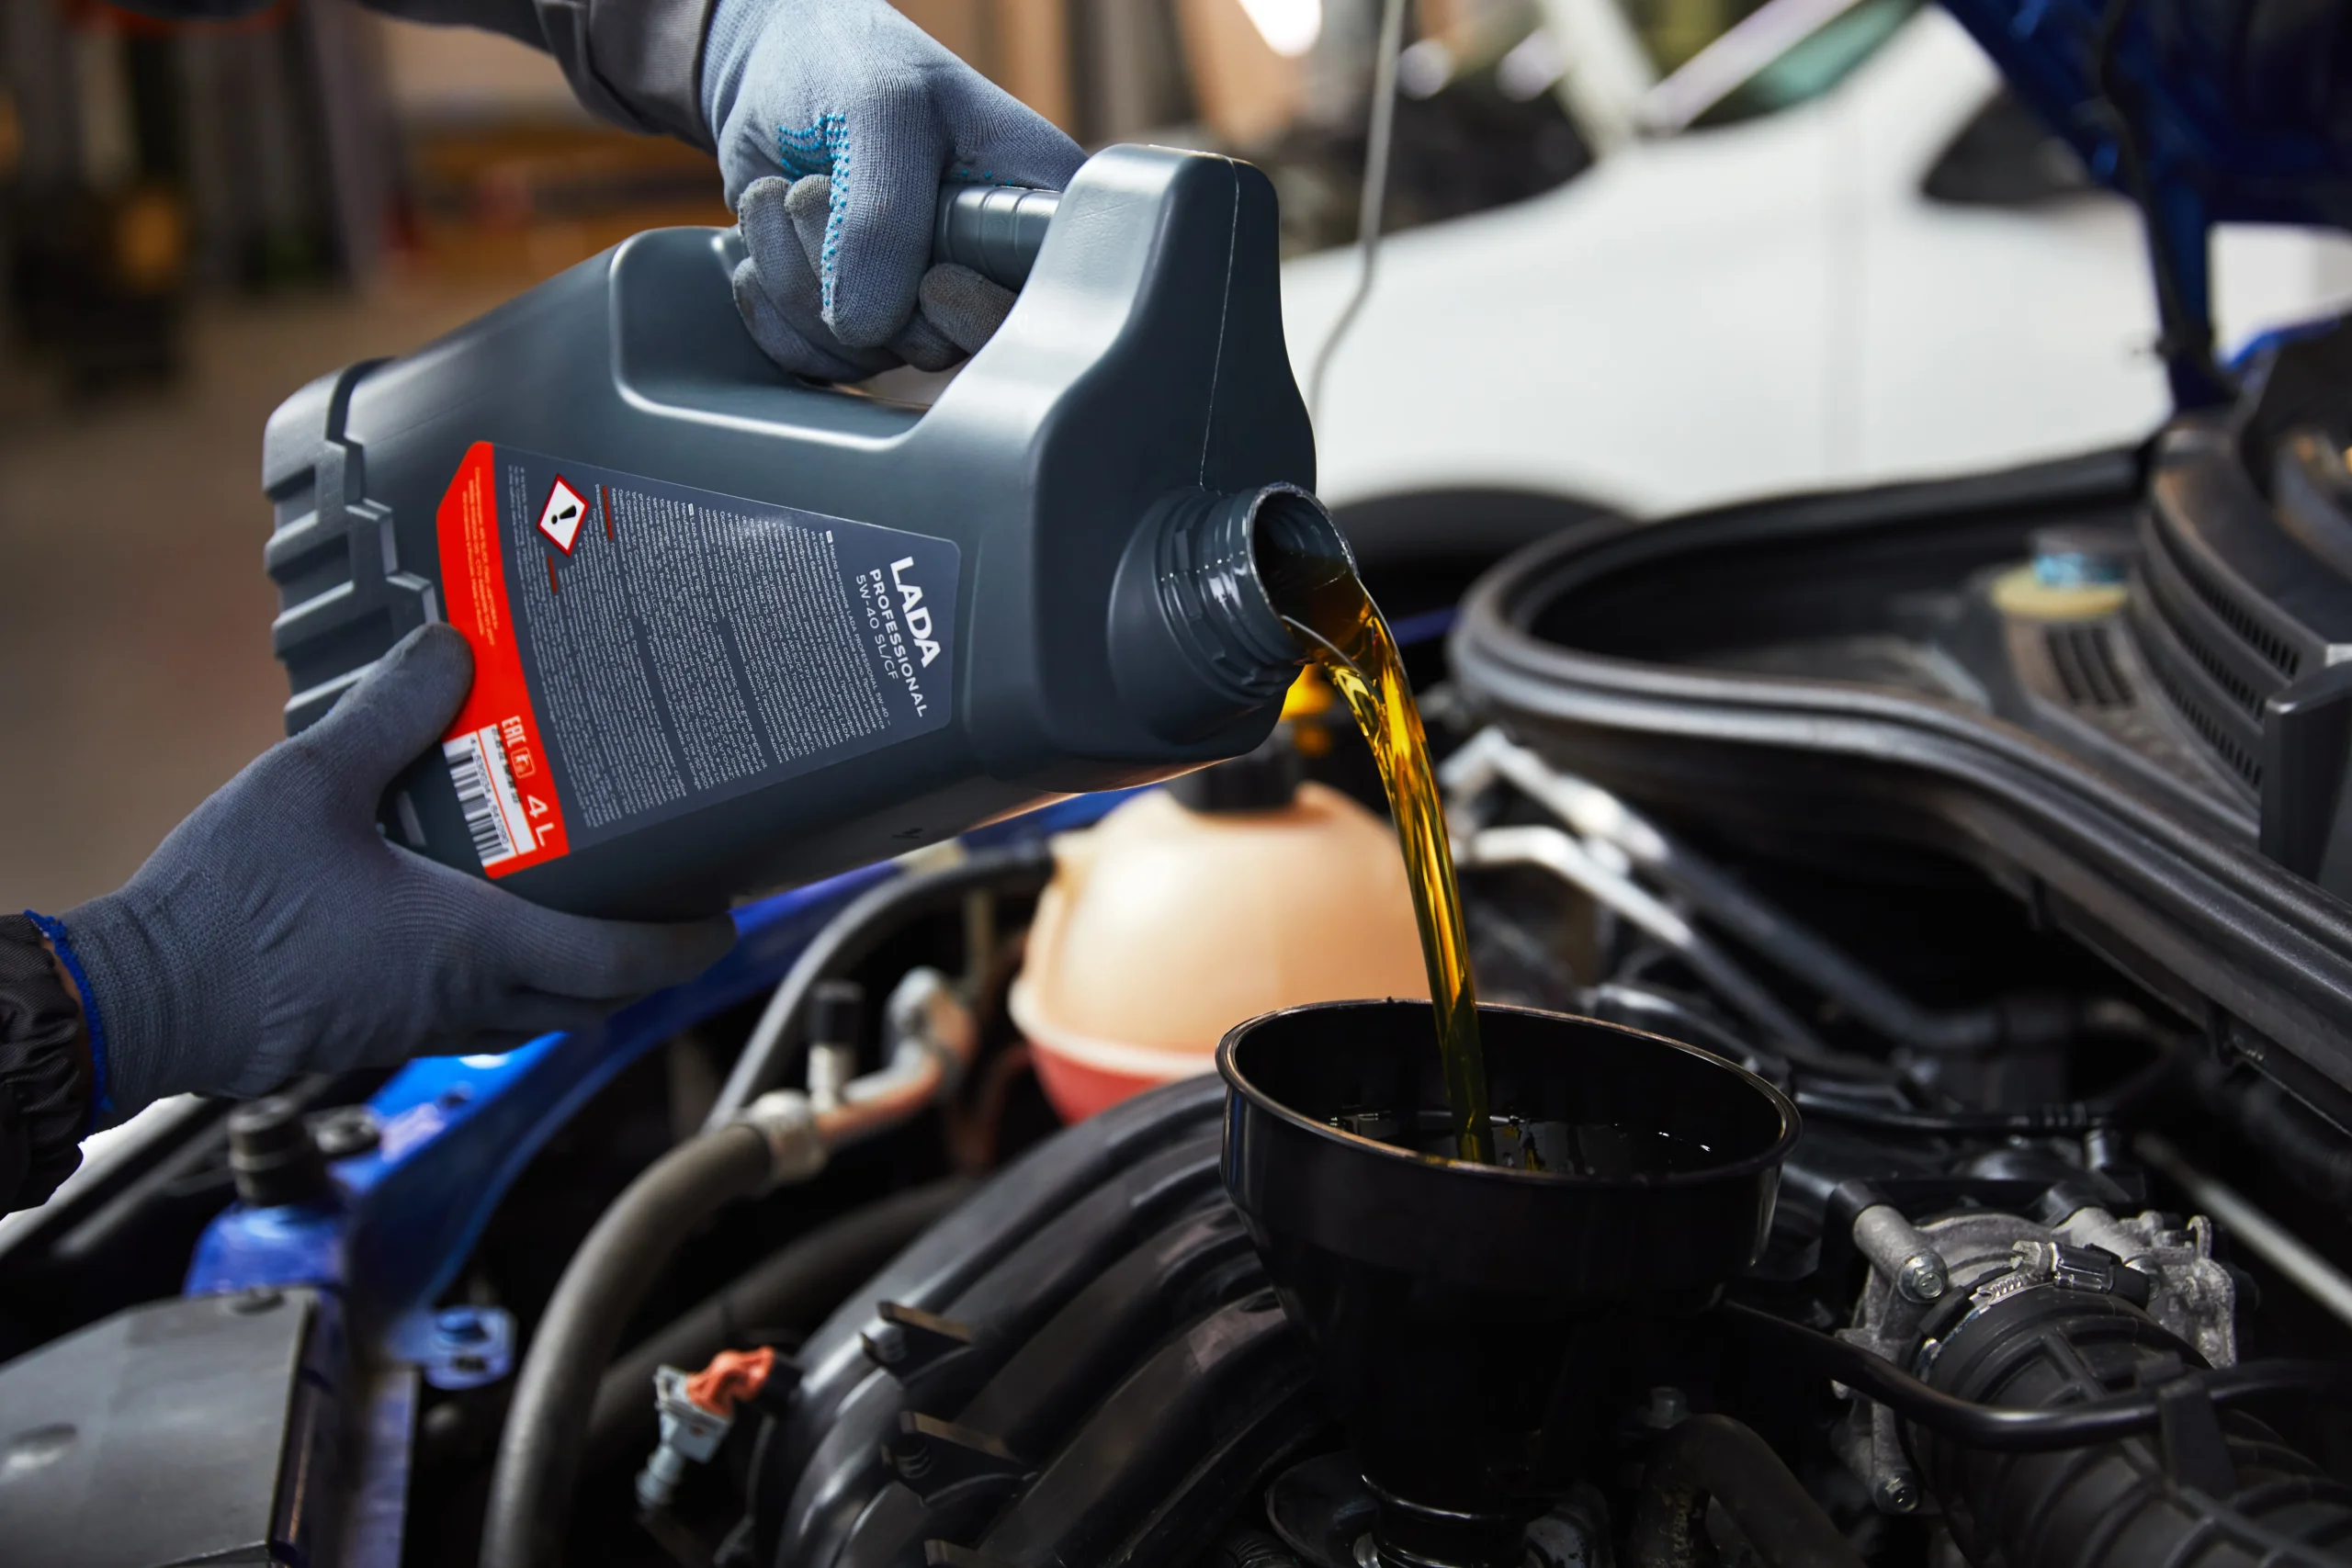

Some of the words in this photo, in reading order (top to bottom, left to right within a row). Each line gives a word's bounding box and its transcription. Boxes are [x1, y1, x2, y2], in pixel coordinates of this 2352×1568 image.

[689, 515, 698, 538] LADA
[693, 538, 711, 595] PROFESSIONAL
[706, 596, 718, 623] 5W-40
[856, 575, 879, 628] 5W-40
[875, 635, 898, 678] SL/CF
[890, 557, 941, 668] LADA
[680, 501, 695, 554] Manufactured
[689, 555, 698, 577] using
[694, 577, 710, 622] high-quality
[706, 623, 721, 659] synthetic
[717, 660, 728, 679] base
[723, 679, 732, 694] oils
[729, 694, 744, 724] blended
[740, 725, 751, 742] with
[746, 743, 763, 772] mineral
[716, 633, 738, 688] semi-synthetic
[870, 569, 926, 716] PROFESSIONAL
[749, 658, 759, 672] ISO
[845, 609, 858, 632] LADA
[853, 632, 878, 690] PROFESSIONAL
[874, 691, 889, 718] 5W-40
[734, 688, 753, 731] multi-grade
[750, 732, 763, 757] engine
[527, 795, 547, 817] 4
[536, 823, 553, 845] L
